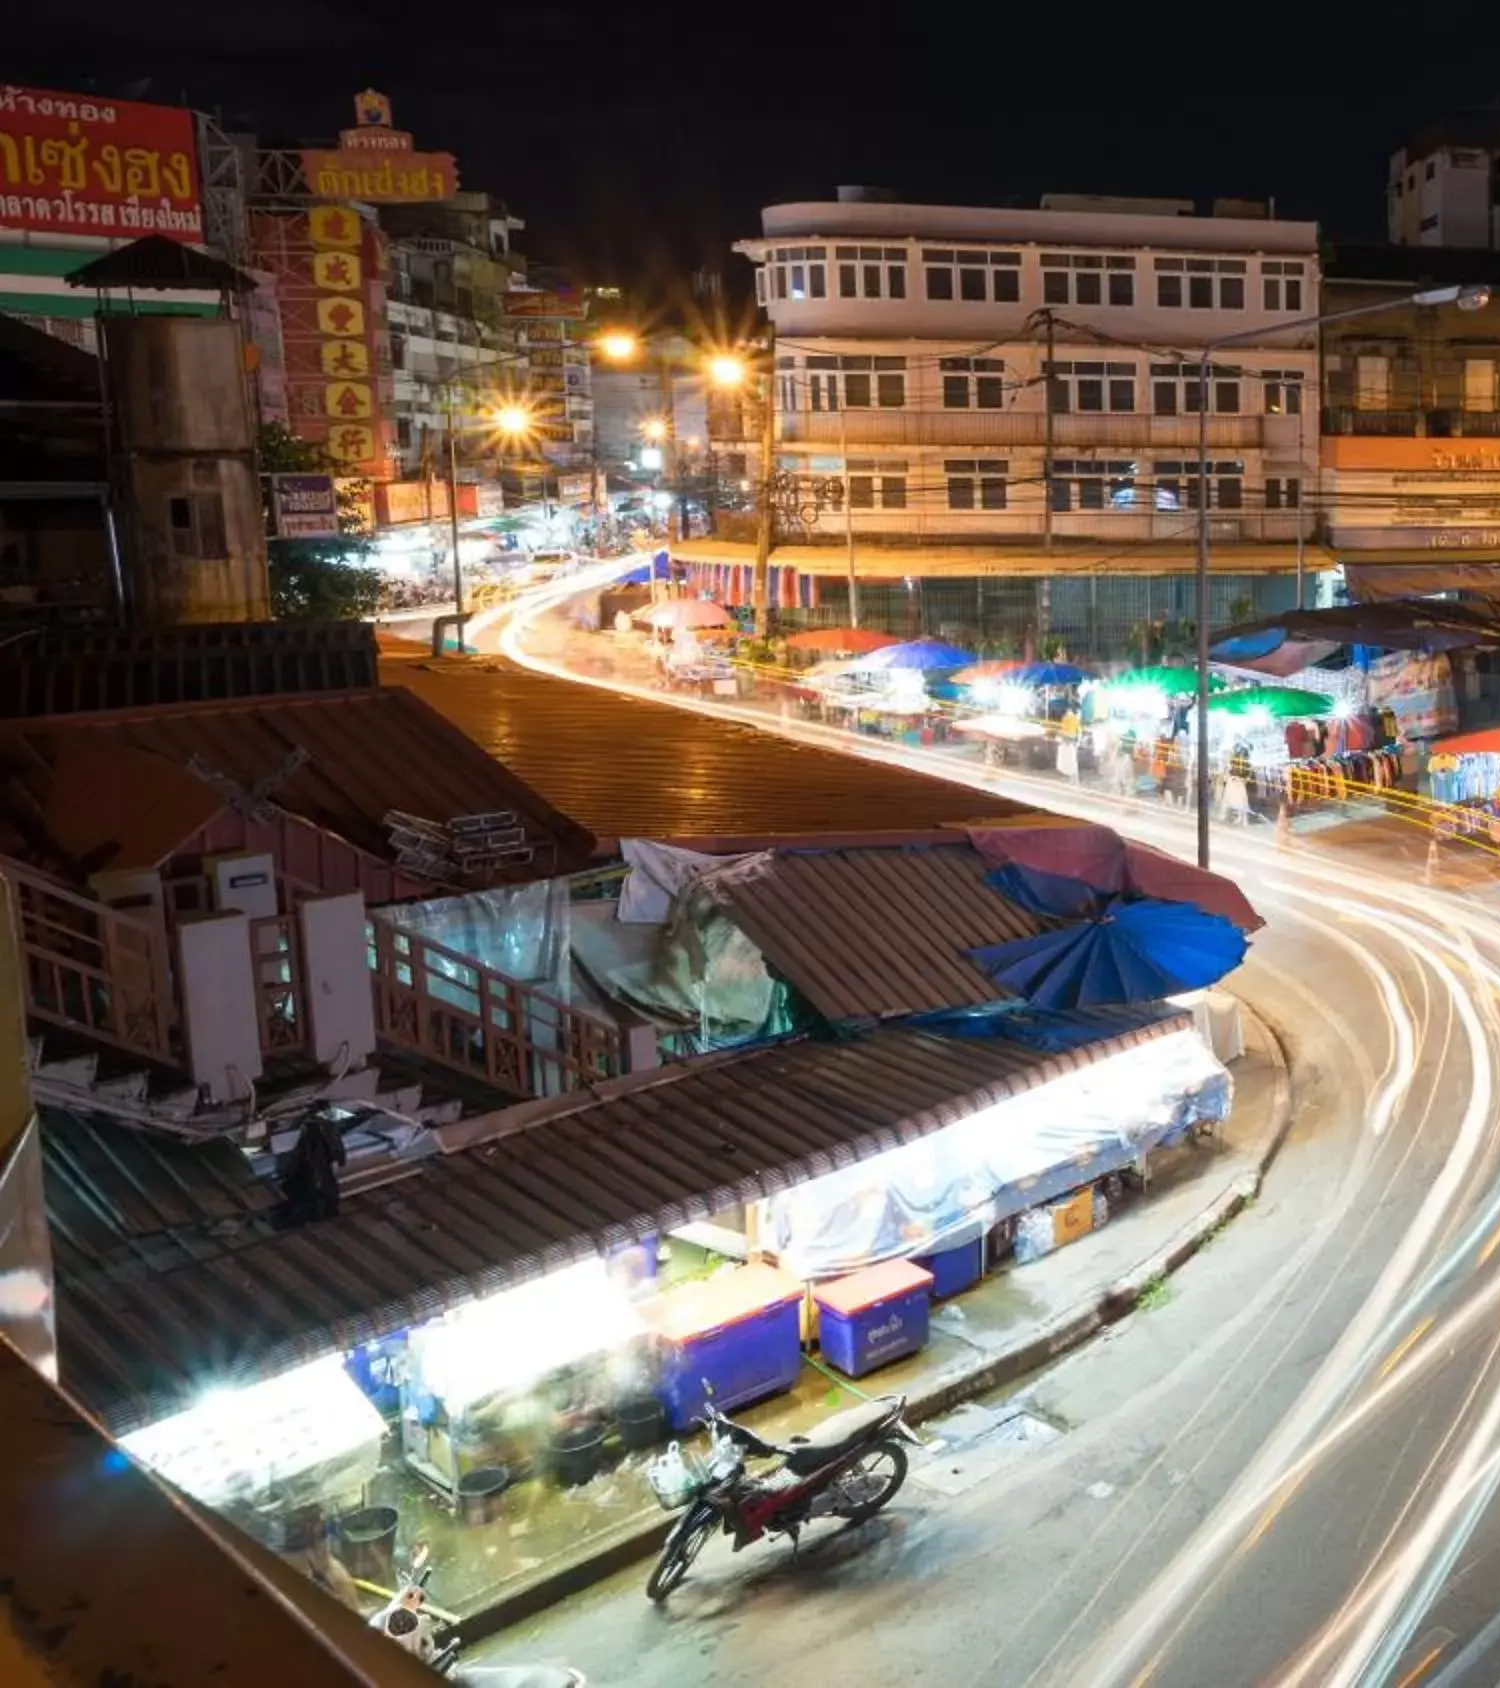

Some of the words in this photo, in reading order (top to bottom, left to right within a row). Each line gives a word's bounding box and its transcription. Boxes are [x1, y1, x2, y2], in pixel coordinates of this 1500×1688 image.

[0, 188, 115, 226] ลาดวโรรส
[119, 194, 202, 233] เชียงใหม่
